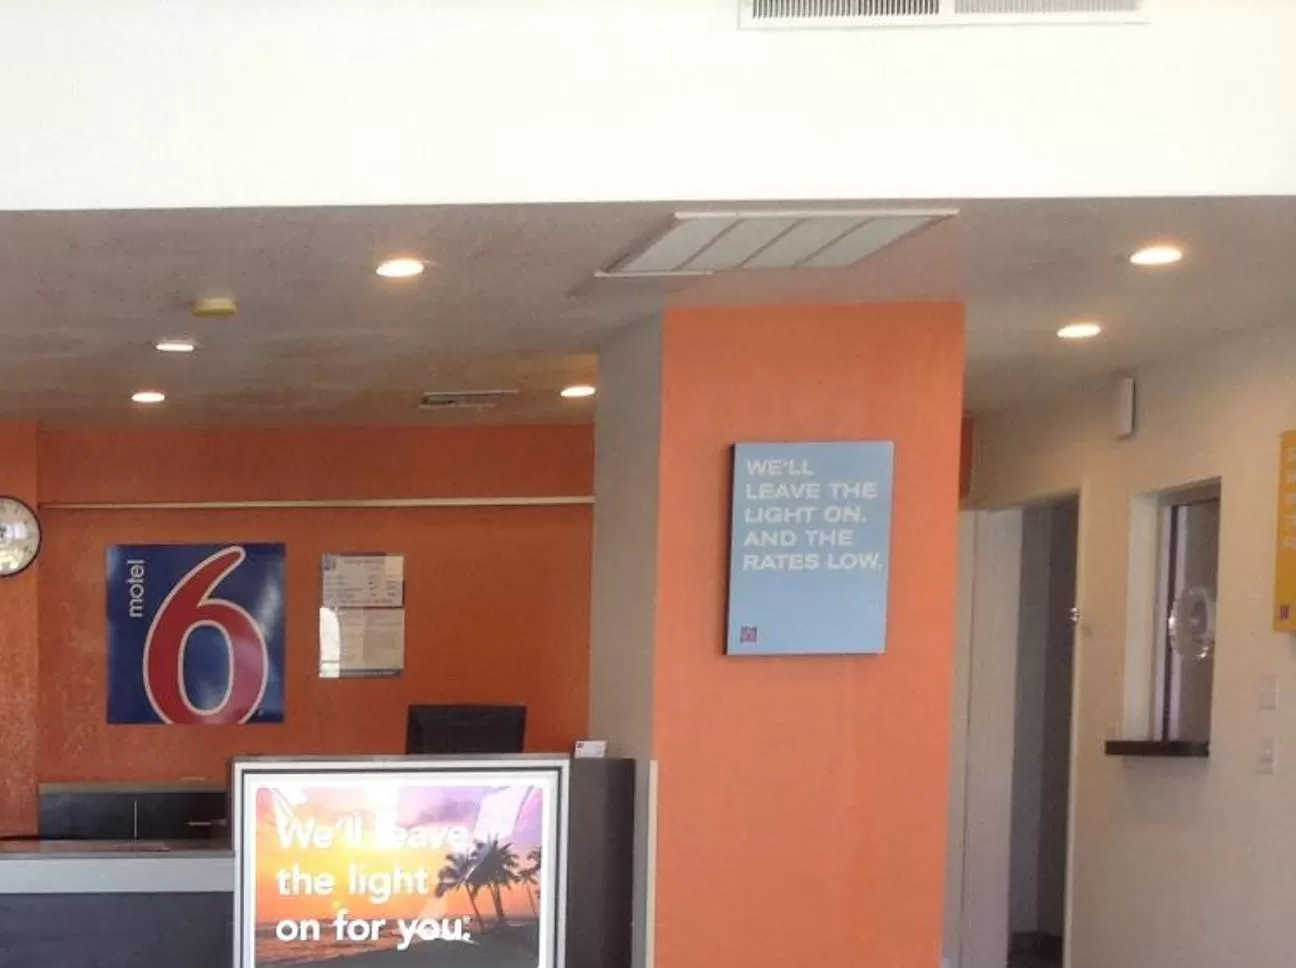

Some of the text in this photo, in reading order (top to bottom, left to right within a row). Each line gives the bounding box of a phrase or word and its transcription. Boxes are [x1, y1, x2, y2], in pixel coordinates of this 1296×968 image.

[747, 459, 815, 477] WE'LL
[745, 481, 879, 500] LEAVE THE
[744, 506, 867, 524] LIGHT ON.
[744, 530, 853, 547] AND THE
[742, 552, 883, 571] RATES LOW.
[127, 559, 146, 618] motel
[143, 546, 269, 724] 6
[274, 814, 363, 850] We'll
[276, 862, 428, 904] the light
[276, 917, 320, 941] on
[332, 907, 386, 941] for
